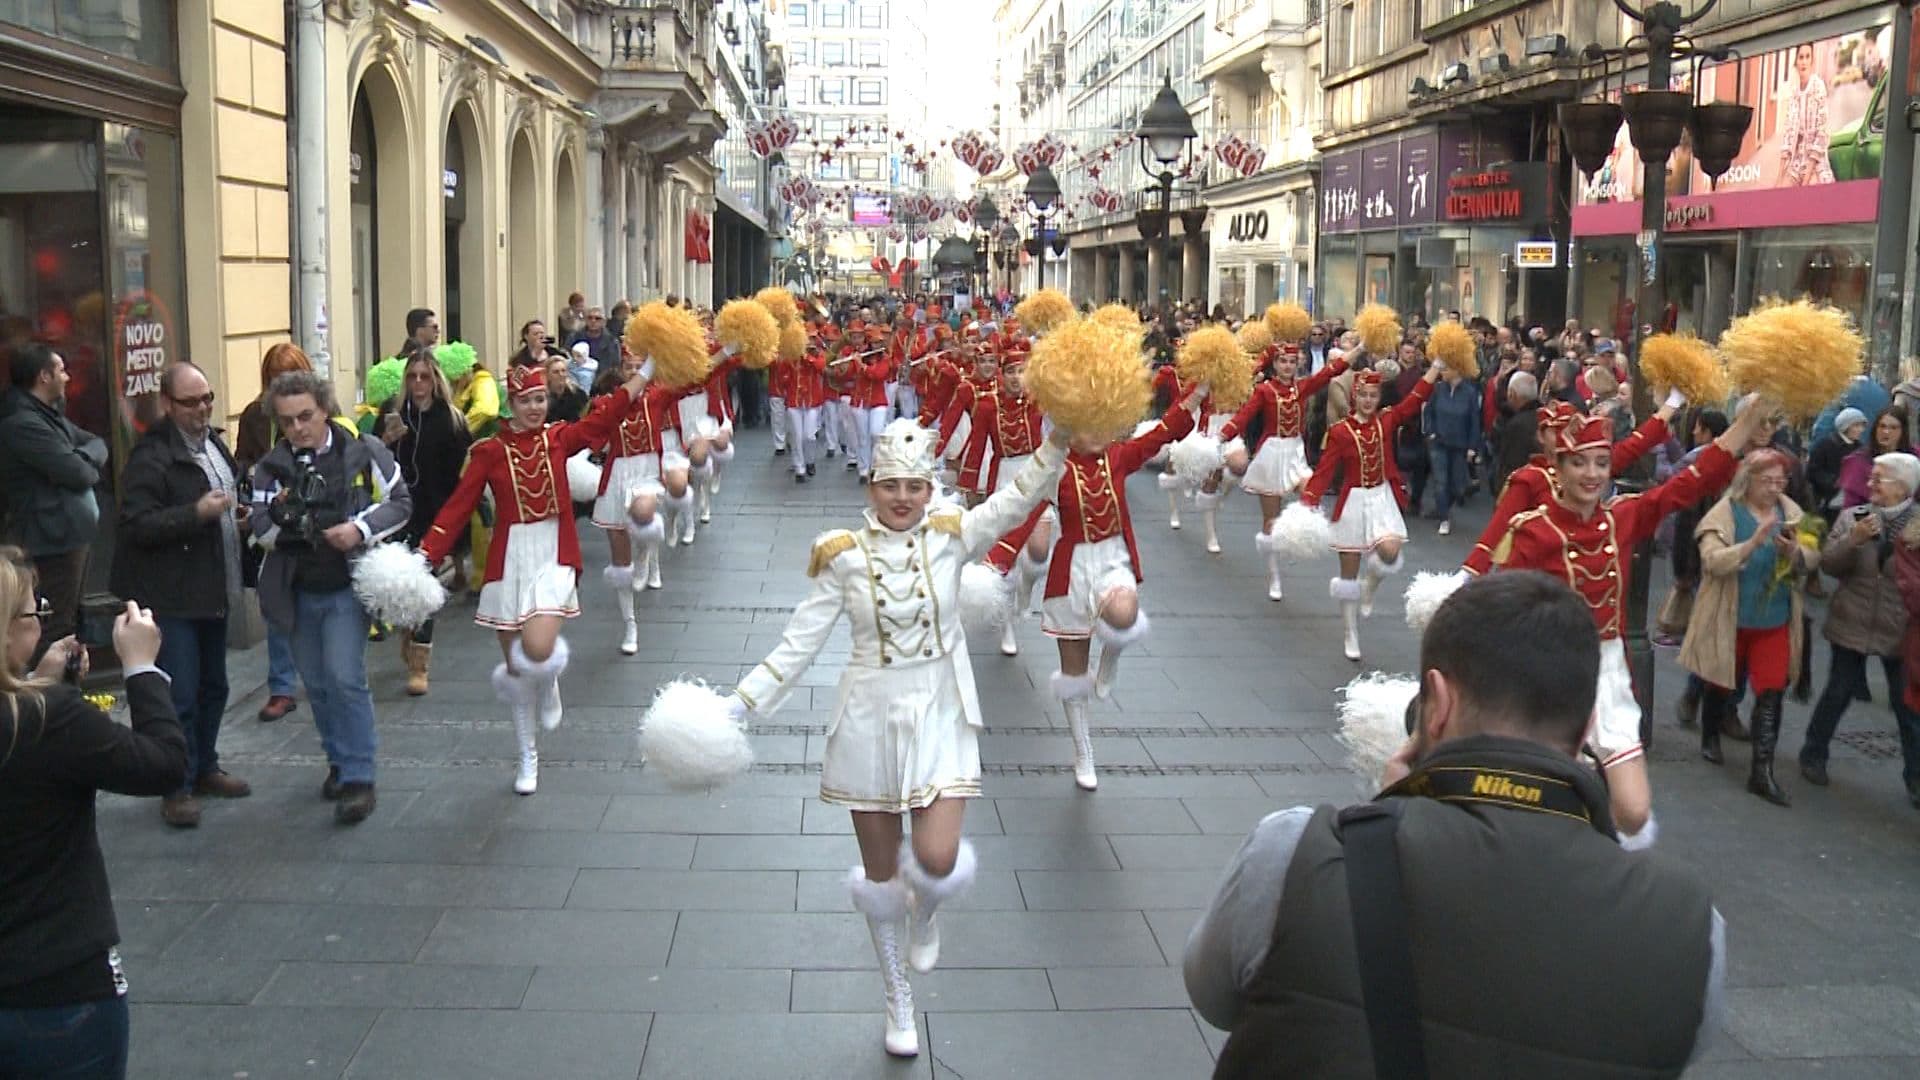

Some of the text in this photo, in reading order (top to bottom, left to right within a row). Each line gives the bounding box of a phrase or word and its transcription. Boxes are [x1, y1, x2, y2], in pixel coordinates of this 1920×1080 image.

[1228, 210, 1269, 242] ALDO
[126, 323, 164, 345] NOVO
[126, 347, 165, 371] MESTO
[1472, 774, 1542, 802] Nikon
